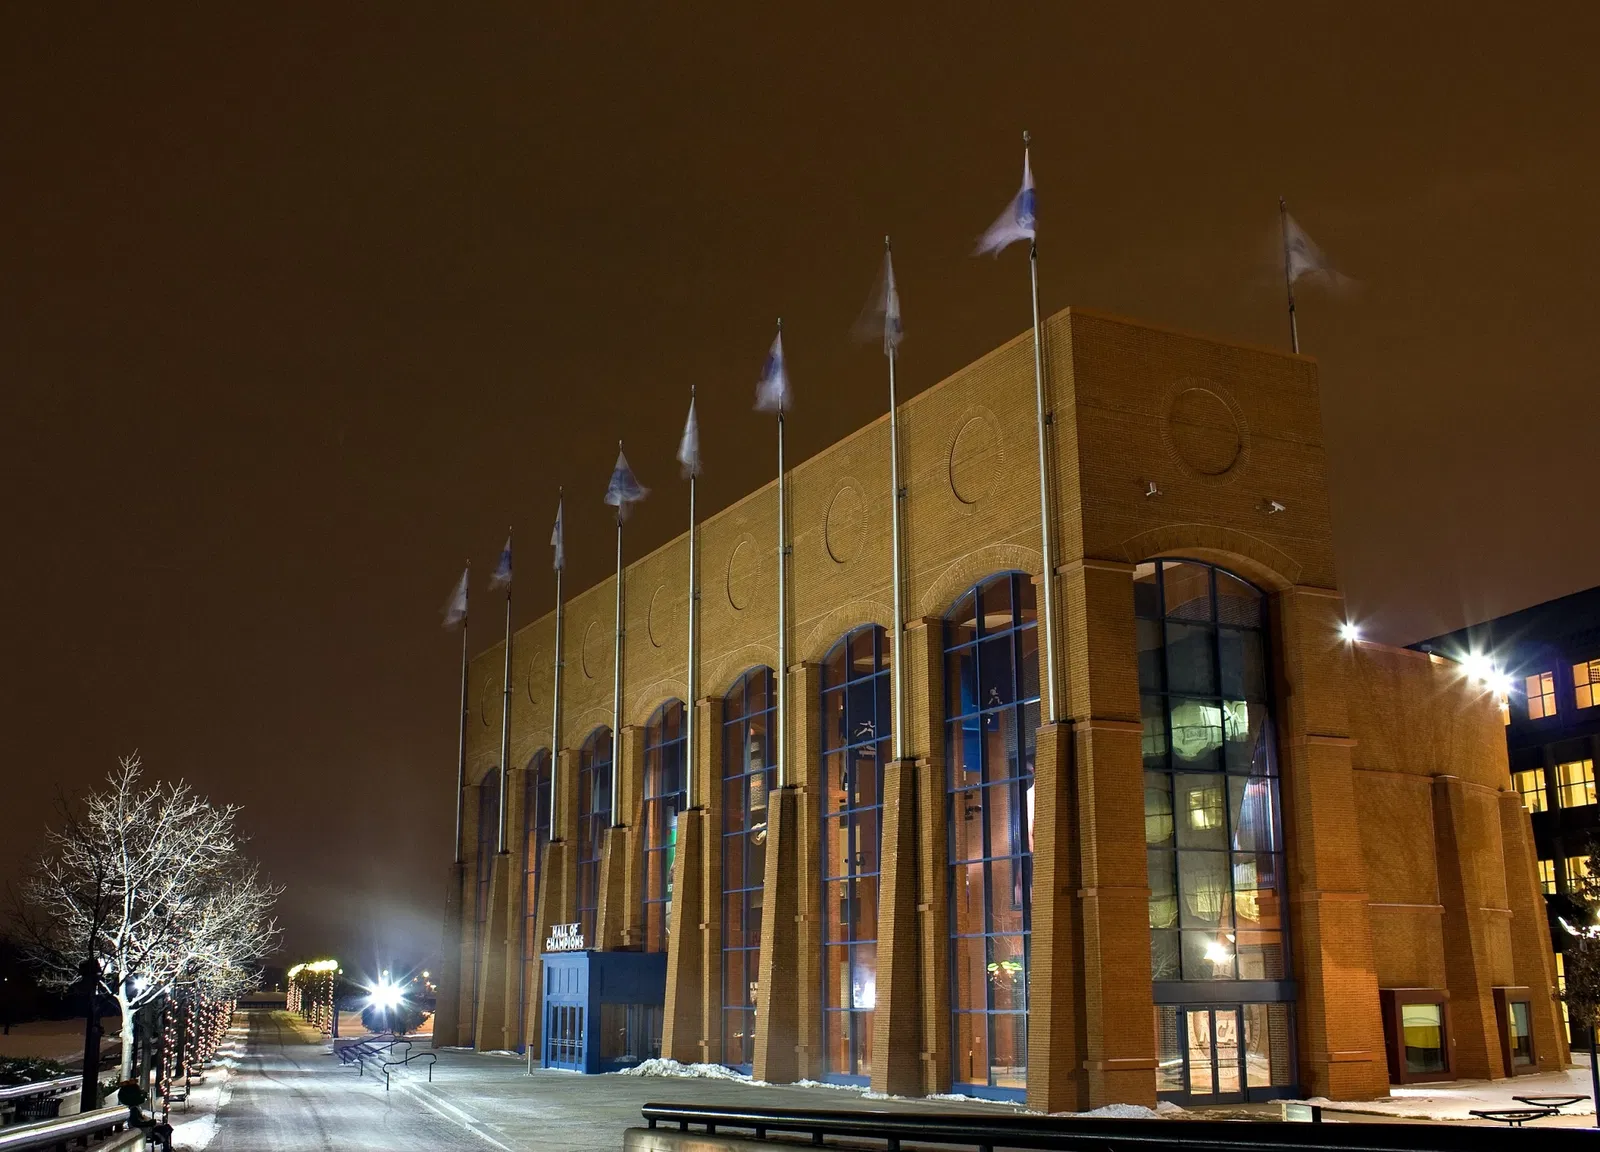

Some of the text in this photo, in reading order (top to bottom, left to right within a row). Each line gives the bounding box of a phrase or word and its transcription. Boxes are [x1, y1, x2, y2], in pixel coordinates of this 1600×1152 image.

[552, 923, 578, 938] HALL OF
[546, 935, 584, 950] CHAMPIONS
